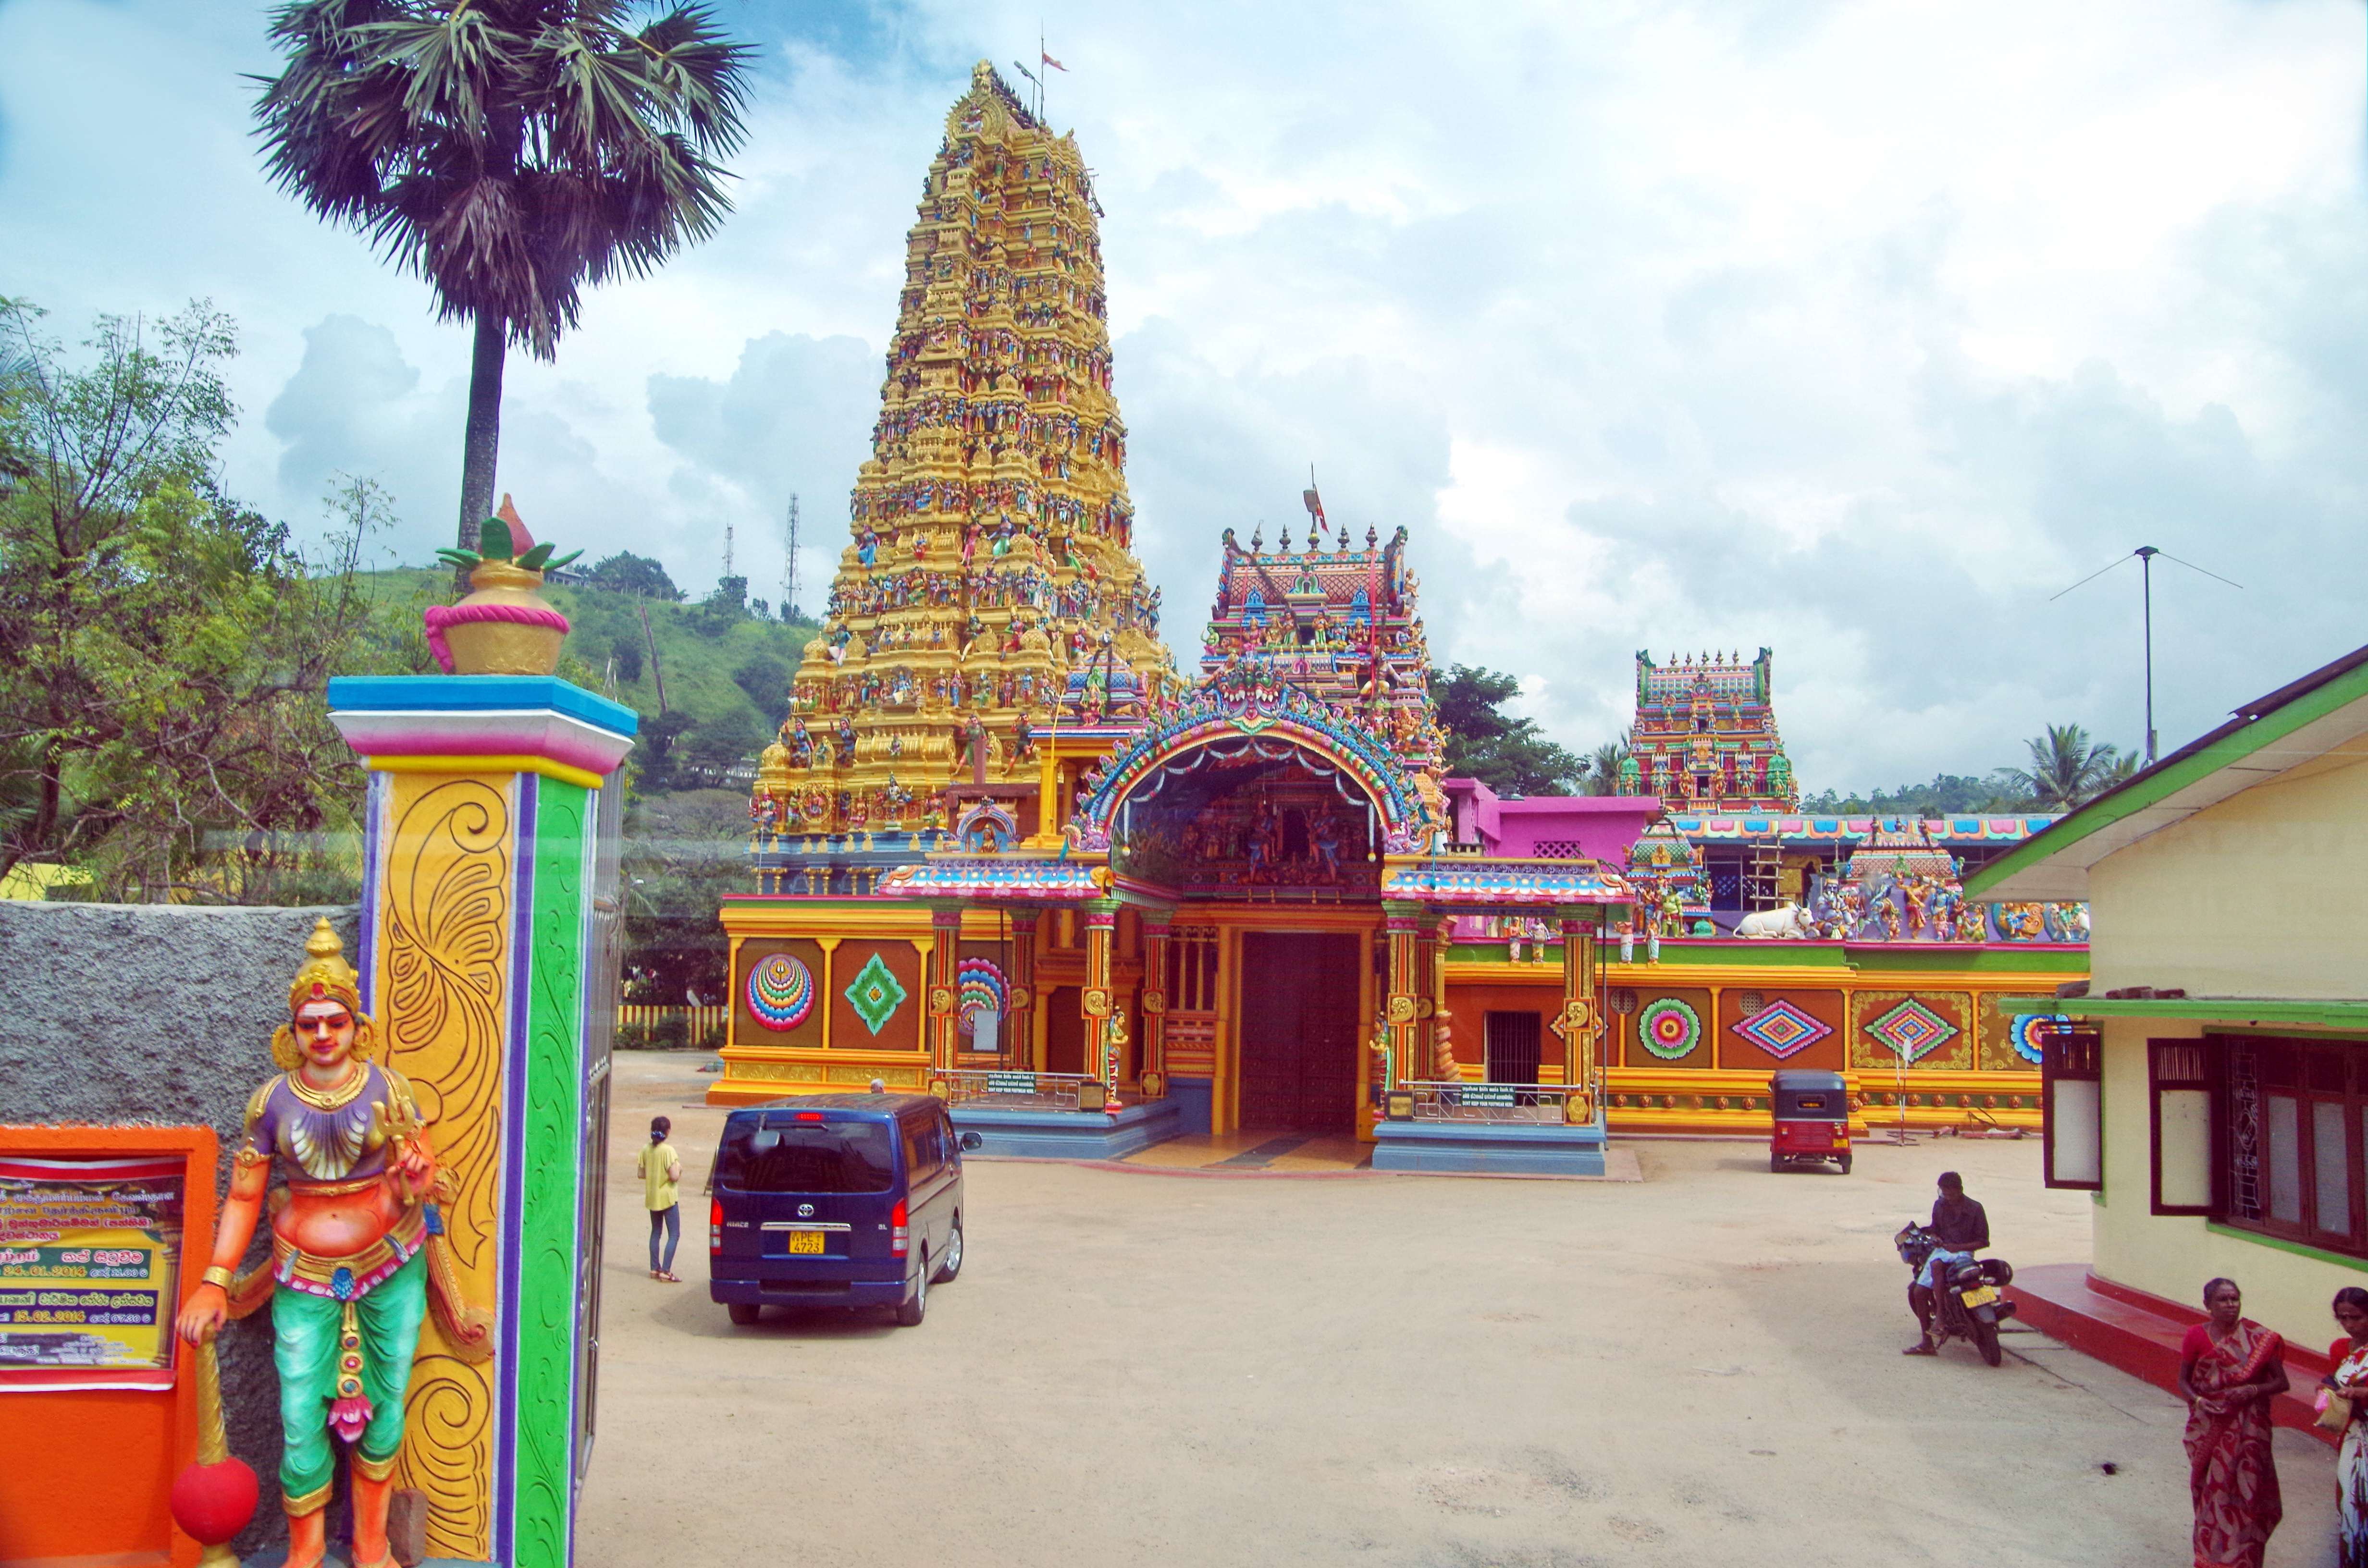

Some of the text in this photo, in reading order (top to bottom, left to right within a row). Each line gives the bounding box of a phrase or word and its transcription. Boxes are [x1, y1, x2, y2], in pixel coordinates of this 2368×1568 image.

[801, 1231, 814, 1242] PE
[794, 1243, 820, 1253] 4723
[3, 1265, 87, 1277] 24.01.2014
[14, 1310, 86, 1322] 15.02.2014
